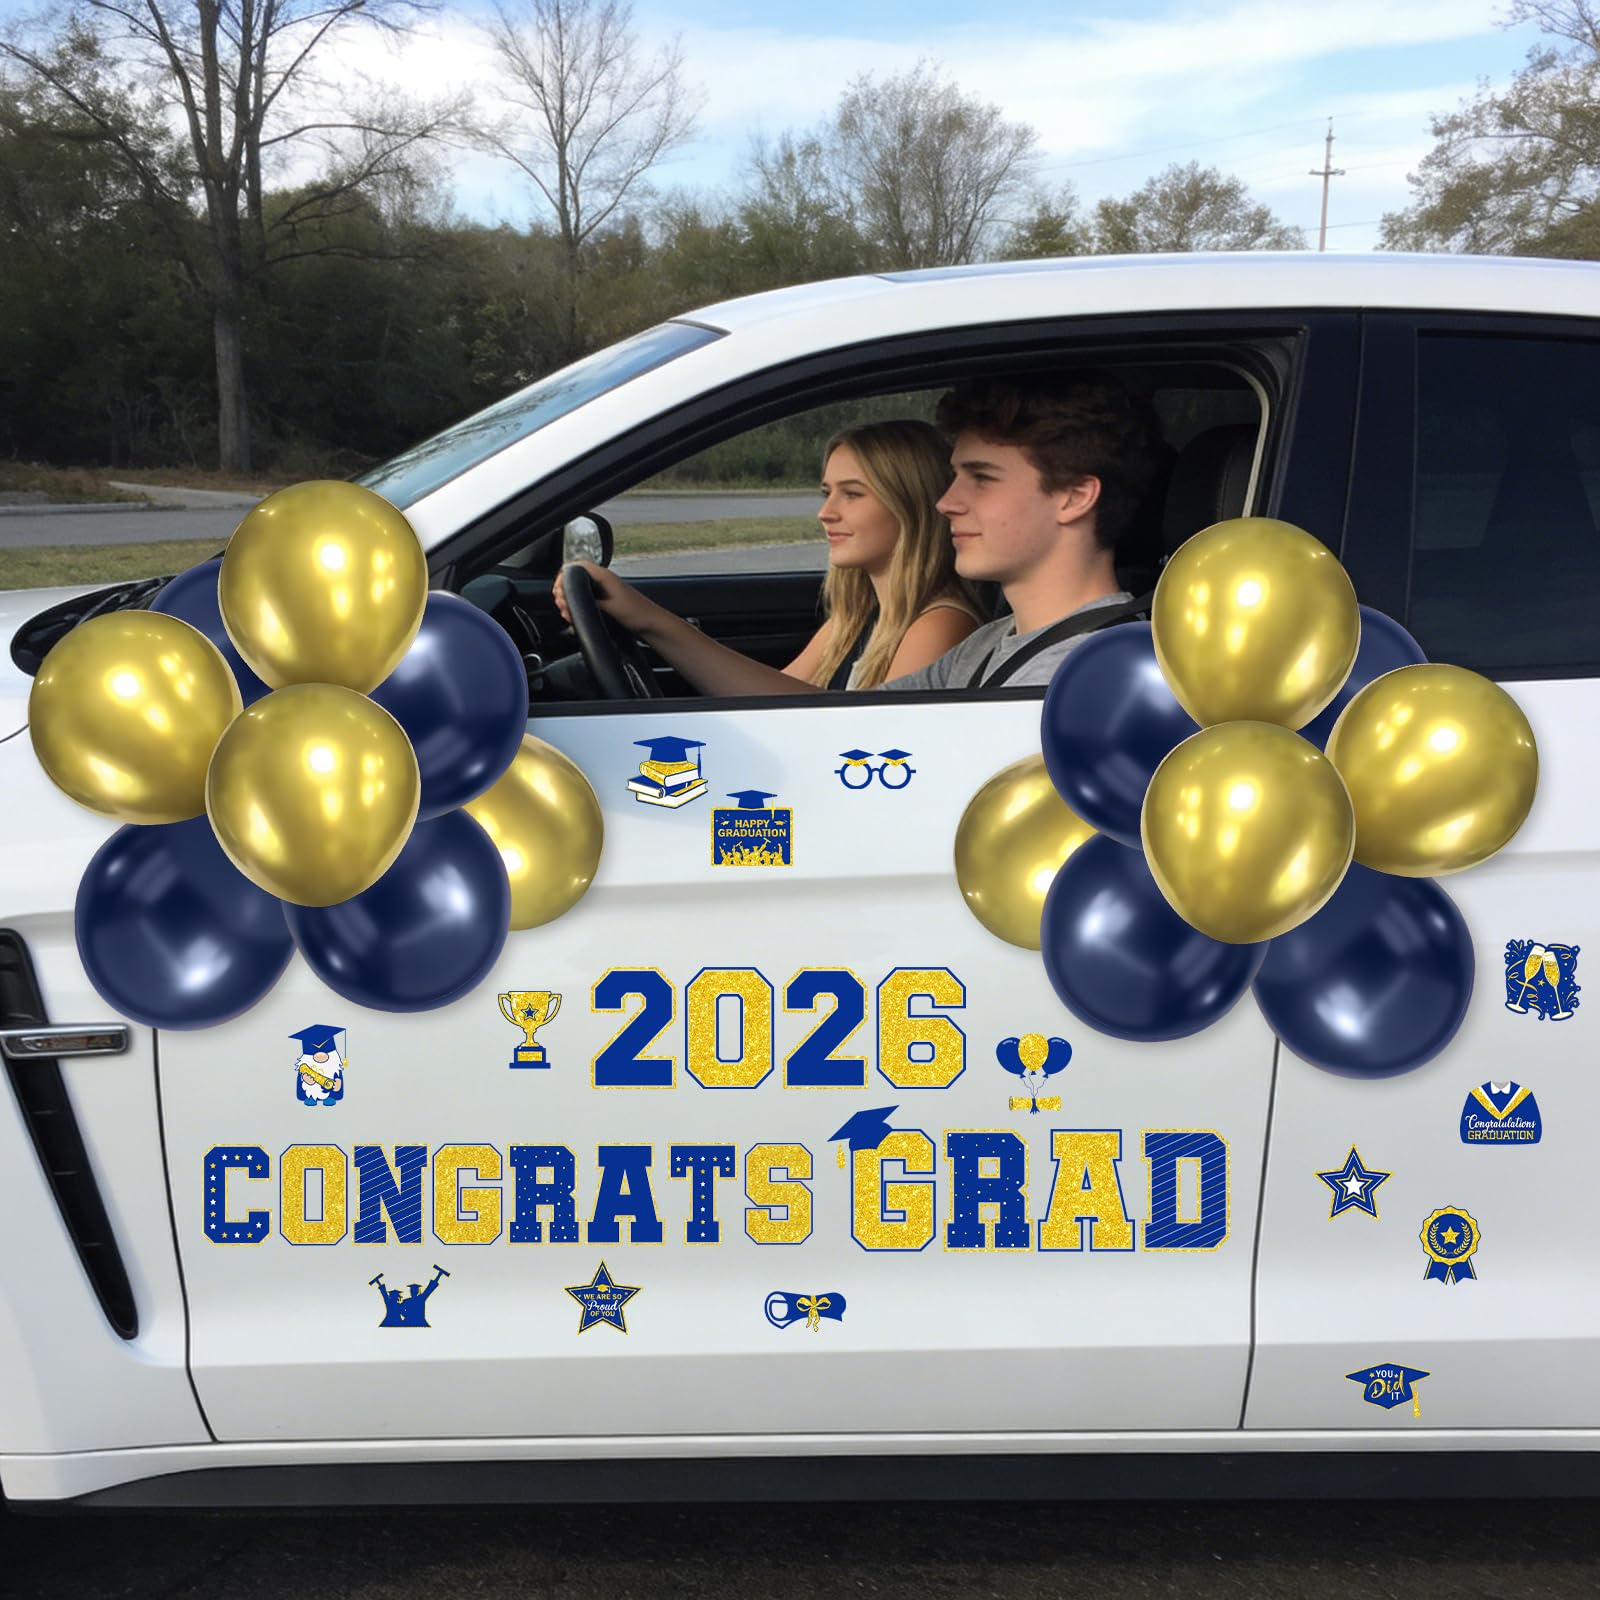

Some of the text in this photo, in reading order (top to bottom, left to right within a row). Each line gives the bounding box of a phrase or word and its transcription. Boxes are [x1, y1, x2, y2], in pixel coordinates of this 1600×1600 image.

[735, 820, 770, 828] HAPPY
[717, 829, 787, 837] GRADUATION
[591, 966, 967, 1089] 2026
[1465, 1114, 1536, 1134] Congratulations
[1467, 1130, 1534, 1140] GRADUATION
[202, 1128, 1233, 1252] CONGRATS GRAD
[588, 1300, 618, 1310] Proud
[1375, 1370, 1394, 1378] YOU
[1368, 1370, 1406, 1398] Did
[1391, 1392, 1400, 1400] IT
